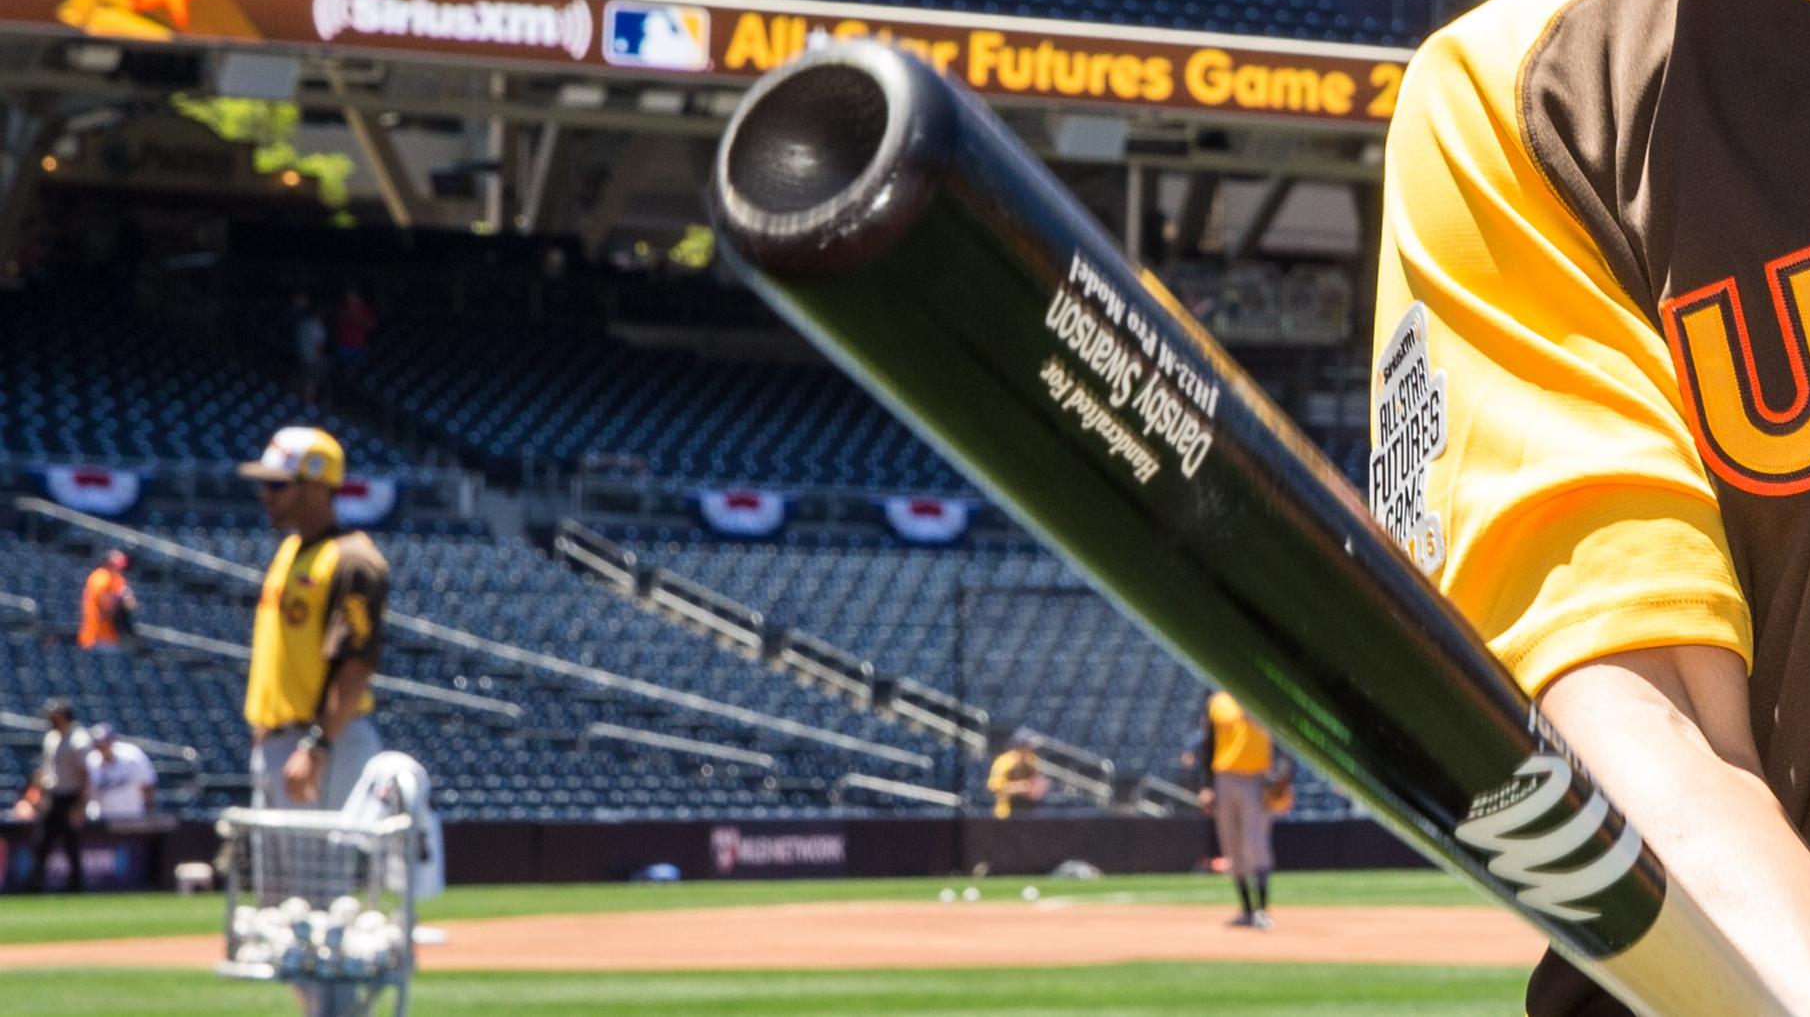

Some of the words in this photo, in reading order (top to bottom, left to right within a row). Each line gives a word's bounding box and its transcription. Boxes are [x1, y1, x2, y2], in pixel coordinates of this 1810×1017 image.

[966, 30, 1174, 103] Futures
[1184, 47, 1356, 116] Game
[1066, 248, 1128, 326] Model
[1044, 286, 1144, 409] Swanson
[1126, 302, 1160, 359] Pro
[1038, 357, 1076, 403] For
[1060, 384, 1162, 485] Handcrafted
[1131, 370, 1216, 480] Dansby
[1372, 389, 1441, 520] FUTURES
[1385, 466, 1425, 544] GAME
